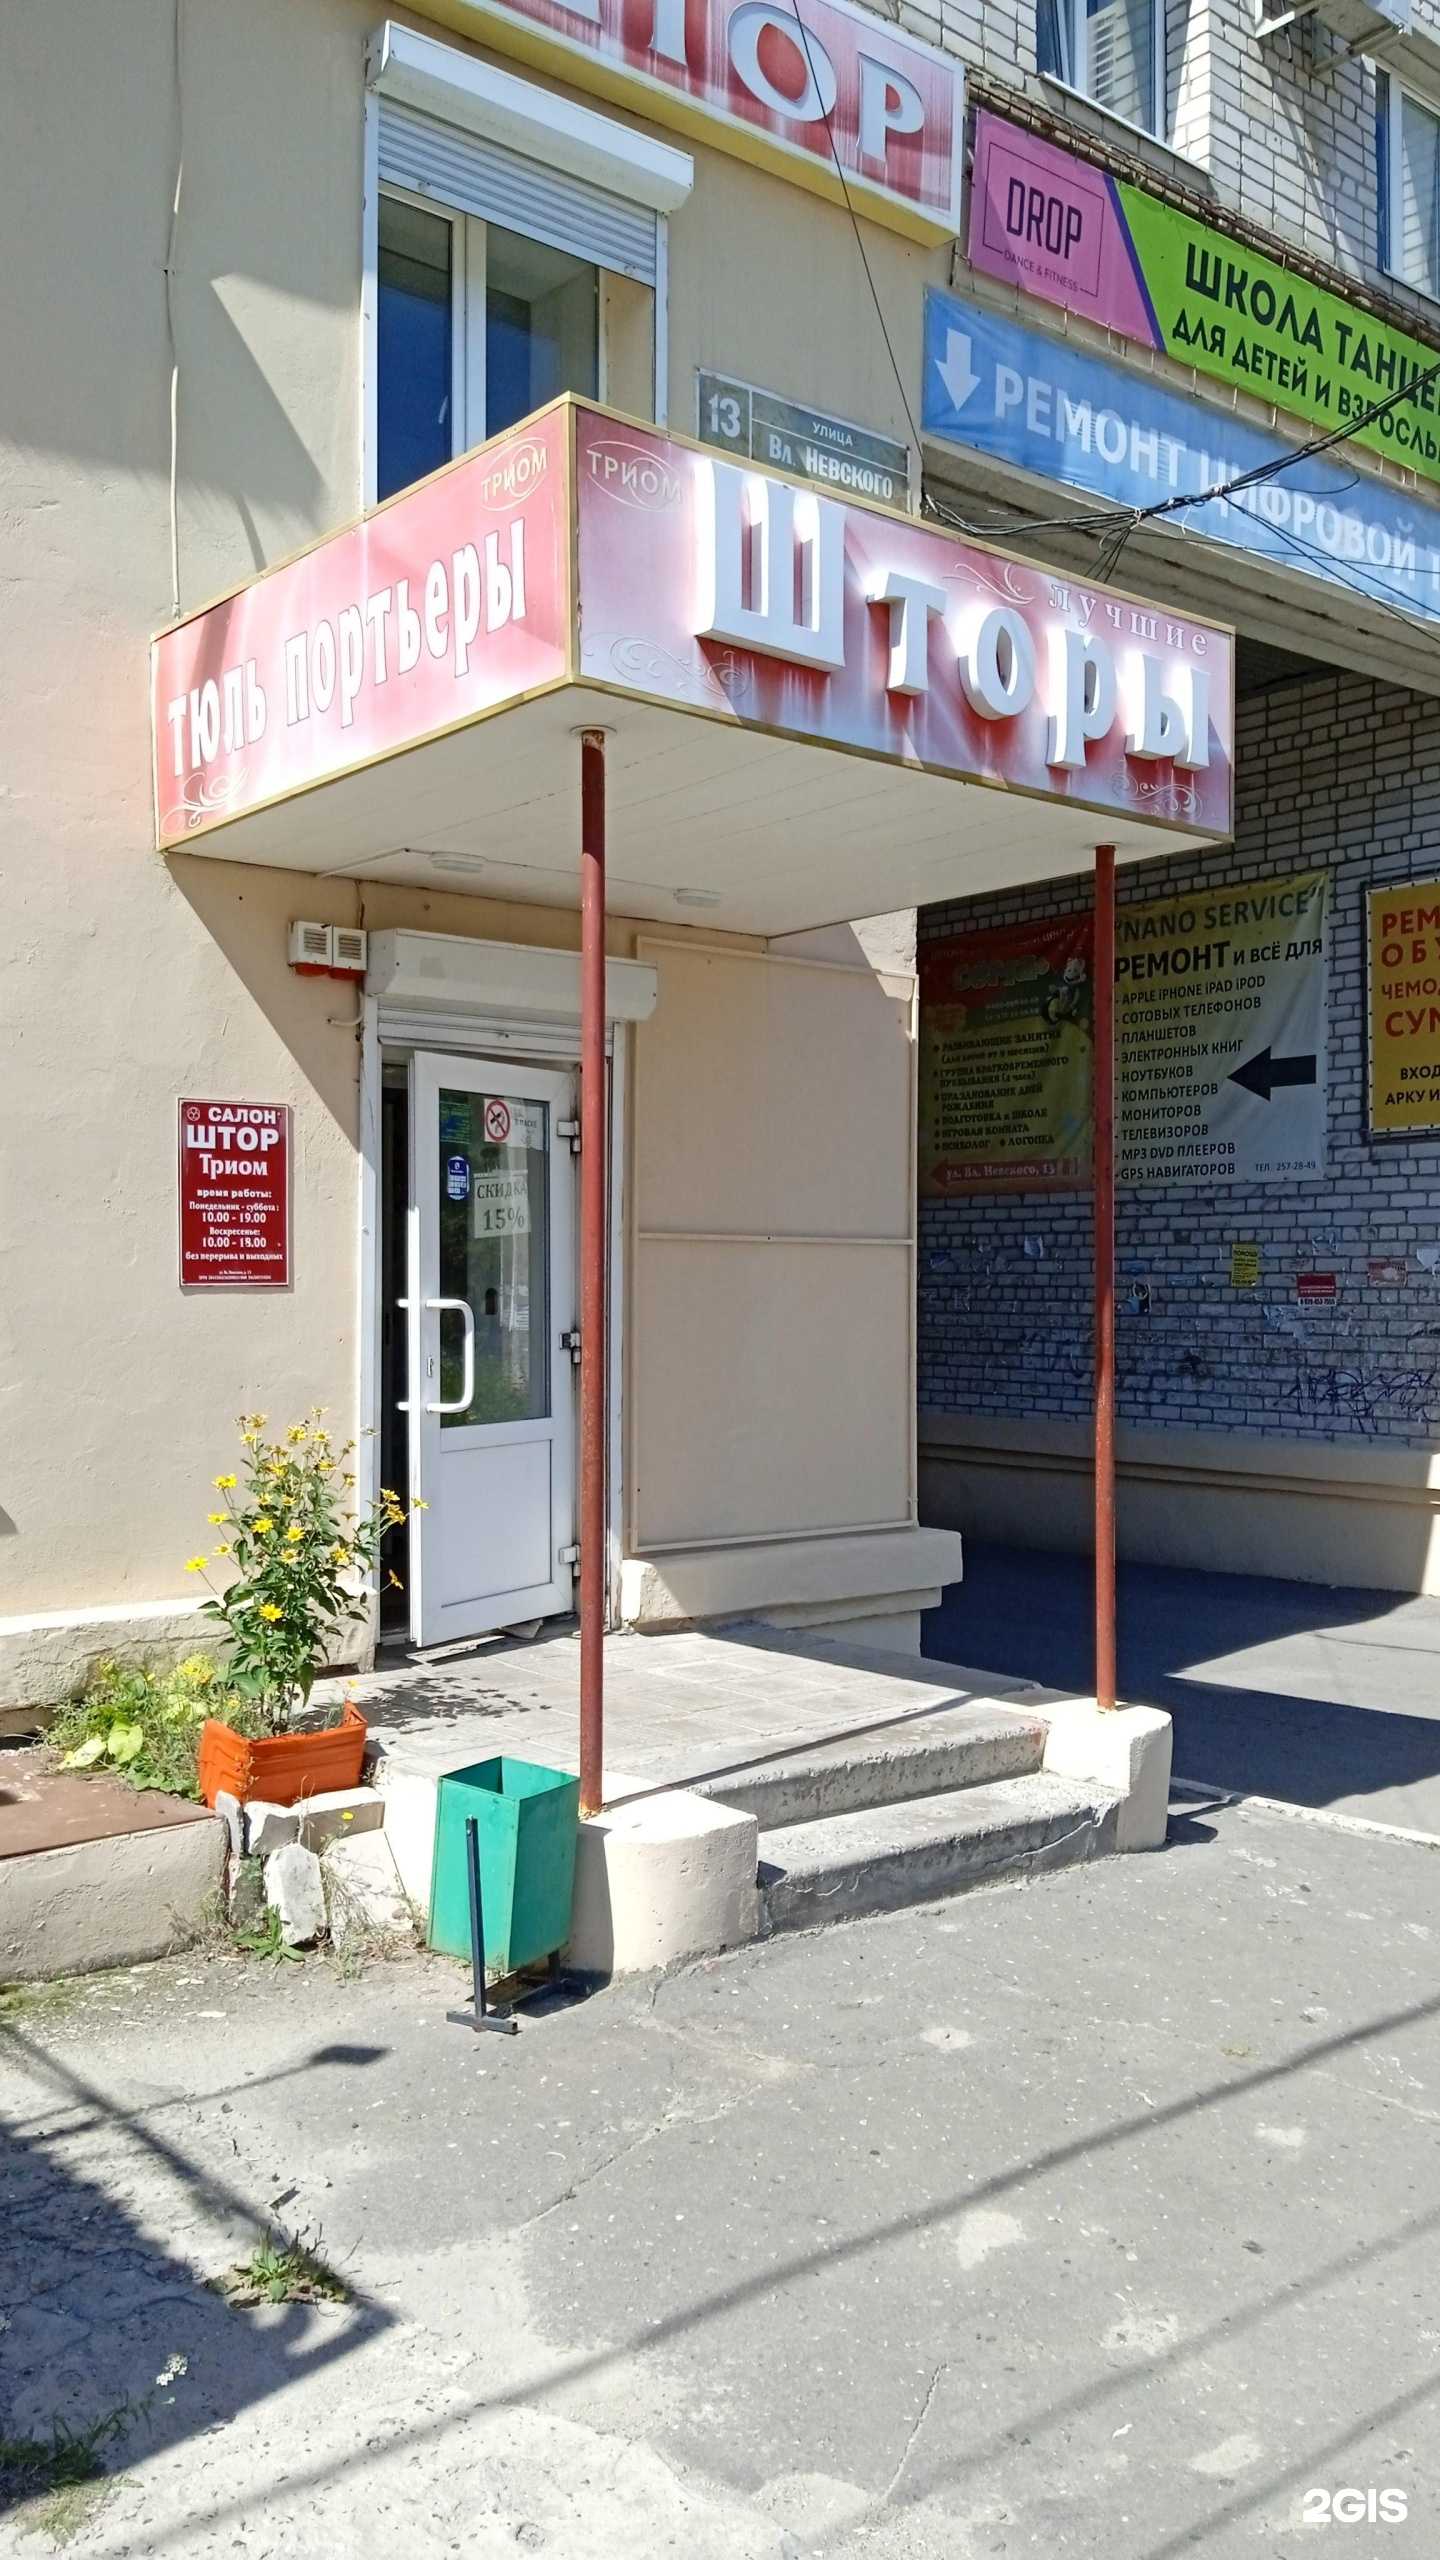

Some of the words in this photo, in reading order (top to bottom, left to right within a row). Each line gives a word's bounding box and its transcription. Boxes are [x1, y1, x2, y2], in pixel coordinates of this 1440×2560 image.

[1006, 176, 1083, 260] DROP
[1004, 249, 1035, 273] DANCE
[1035, 264, 1043, 276] &
[1044, 267, 1079, 292] FITNESS
[1185, 242, 1324, 356] ШКОЛА
[1333, 319, 1440, 416] ТАНЦЕ
[1172, 307, 1227, 360] ДЛЯ
[1232, 335, 1309, 397] ДЕТЕЙ
[1315, 368, 1332, 408] И
[708, 393, 742, 438] 13
[811, 421, 854, 447] УЛИЦА
[481, 446, 549, 502] ТРИОМ
[585, 441, 682, 504] ТРИОМ
[805, 446, 893, 500] НЕВСКОГО
[994, 363, 1189, 488] РЕМОНТ
[1200, 448, 1417, 582] ЦИФРОВОЙ
[284, 517, 527, 730] портьеры
[694, 457, 1212, 772] Шторы
[1047, 581, 1210, 657] лучшие
[1115, 940, 1232, 982] РЕМОНТ
[1250, 940, 1282, 964] ВСЁ
[1285, 937, 1324, 961] ДЛЯ
[1121, 990, 1156, 1007] APPLE
[1381, 977, 1440, 1001] ЧЕМО
[1121, 1007, 1181, 1025] СОТОВЫХ
[1184, 995, 1262, 1018] ТЕЛЕФОНОВ
[1121, 1024, 1197, 1045] ПЛАНШЕТОВ
[1121, 1045, 1209, 1065] ЭЛЕКТРОННЫХ
[1211, 1039, 1245, 1055] КНИГ
[1121, 1065, 1194, 1083] НОУТБУКОВ
[1121, 1083, 1219, 1103] КОМПЬЮТЕРОВ
[1385, 1089, 1425, 1106] АРКУ
[208, 1107, 276, 1124] САЛОН
[1121, 1104, 1202, 1122] МОНИТОРОВ
[186, 1124, 280, 1152] ШТОР
[1121, 1124, 1209, 1142] ТЕЛЕВИЗОРОВ
[1121, 1147, 1147, 1161] MP3
[1149, 1145, 1175, 1159] DVD
[1177, 1142, 1236, 1157] ПЛЕЕРОВ
[199, 1153, 268, 1180] Триом
[1120, 1166, 1144, 1180] GPS
[1146, 1162, 1236, 1179] НАВИГАТОРОВ
[196, 1189, 229, 1199] время
[231, 1188, 272, 1199] работы:
[476, 1178, 528, 1200] СКИДКА
[189, 1201, 240, 1211] Понедельник
[202, 1212, 230, 1223] 10.00
[239, 1212, 267, 1223] 19.00
[483, 1207, 525, 1231] 15%
[202, 1236, 230, 1248] 10.00
[239, 1237, 267, 1248] 18.00
[185, 1251, 199, 1260] без
